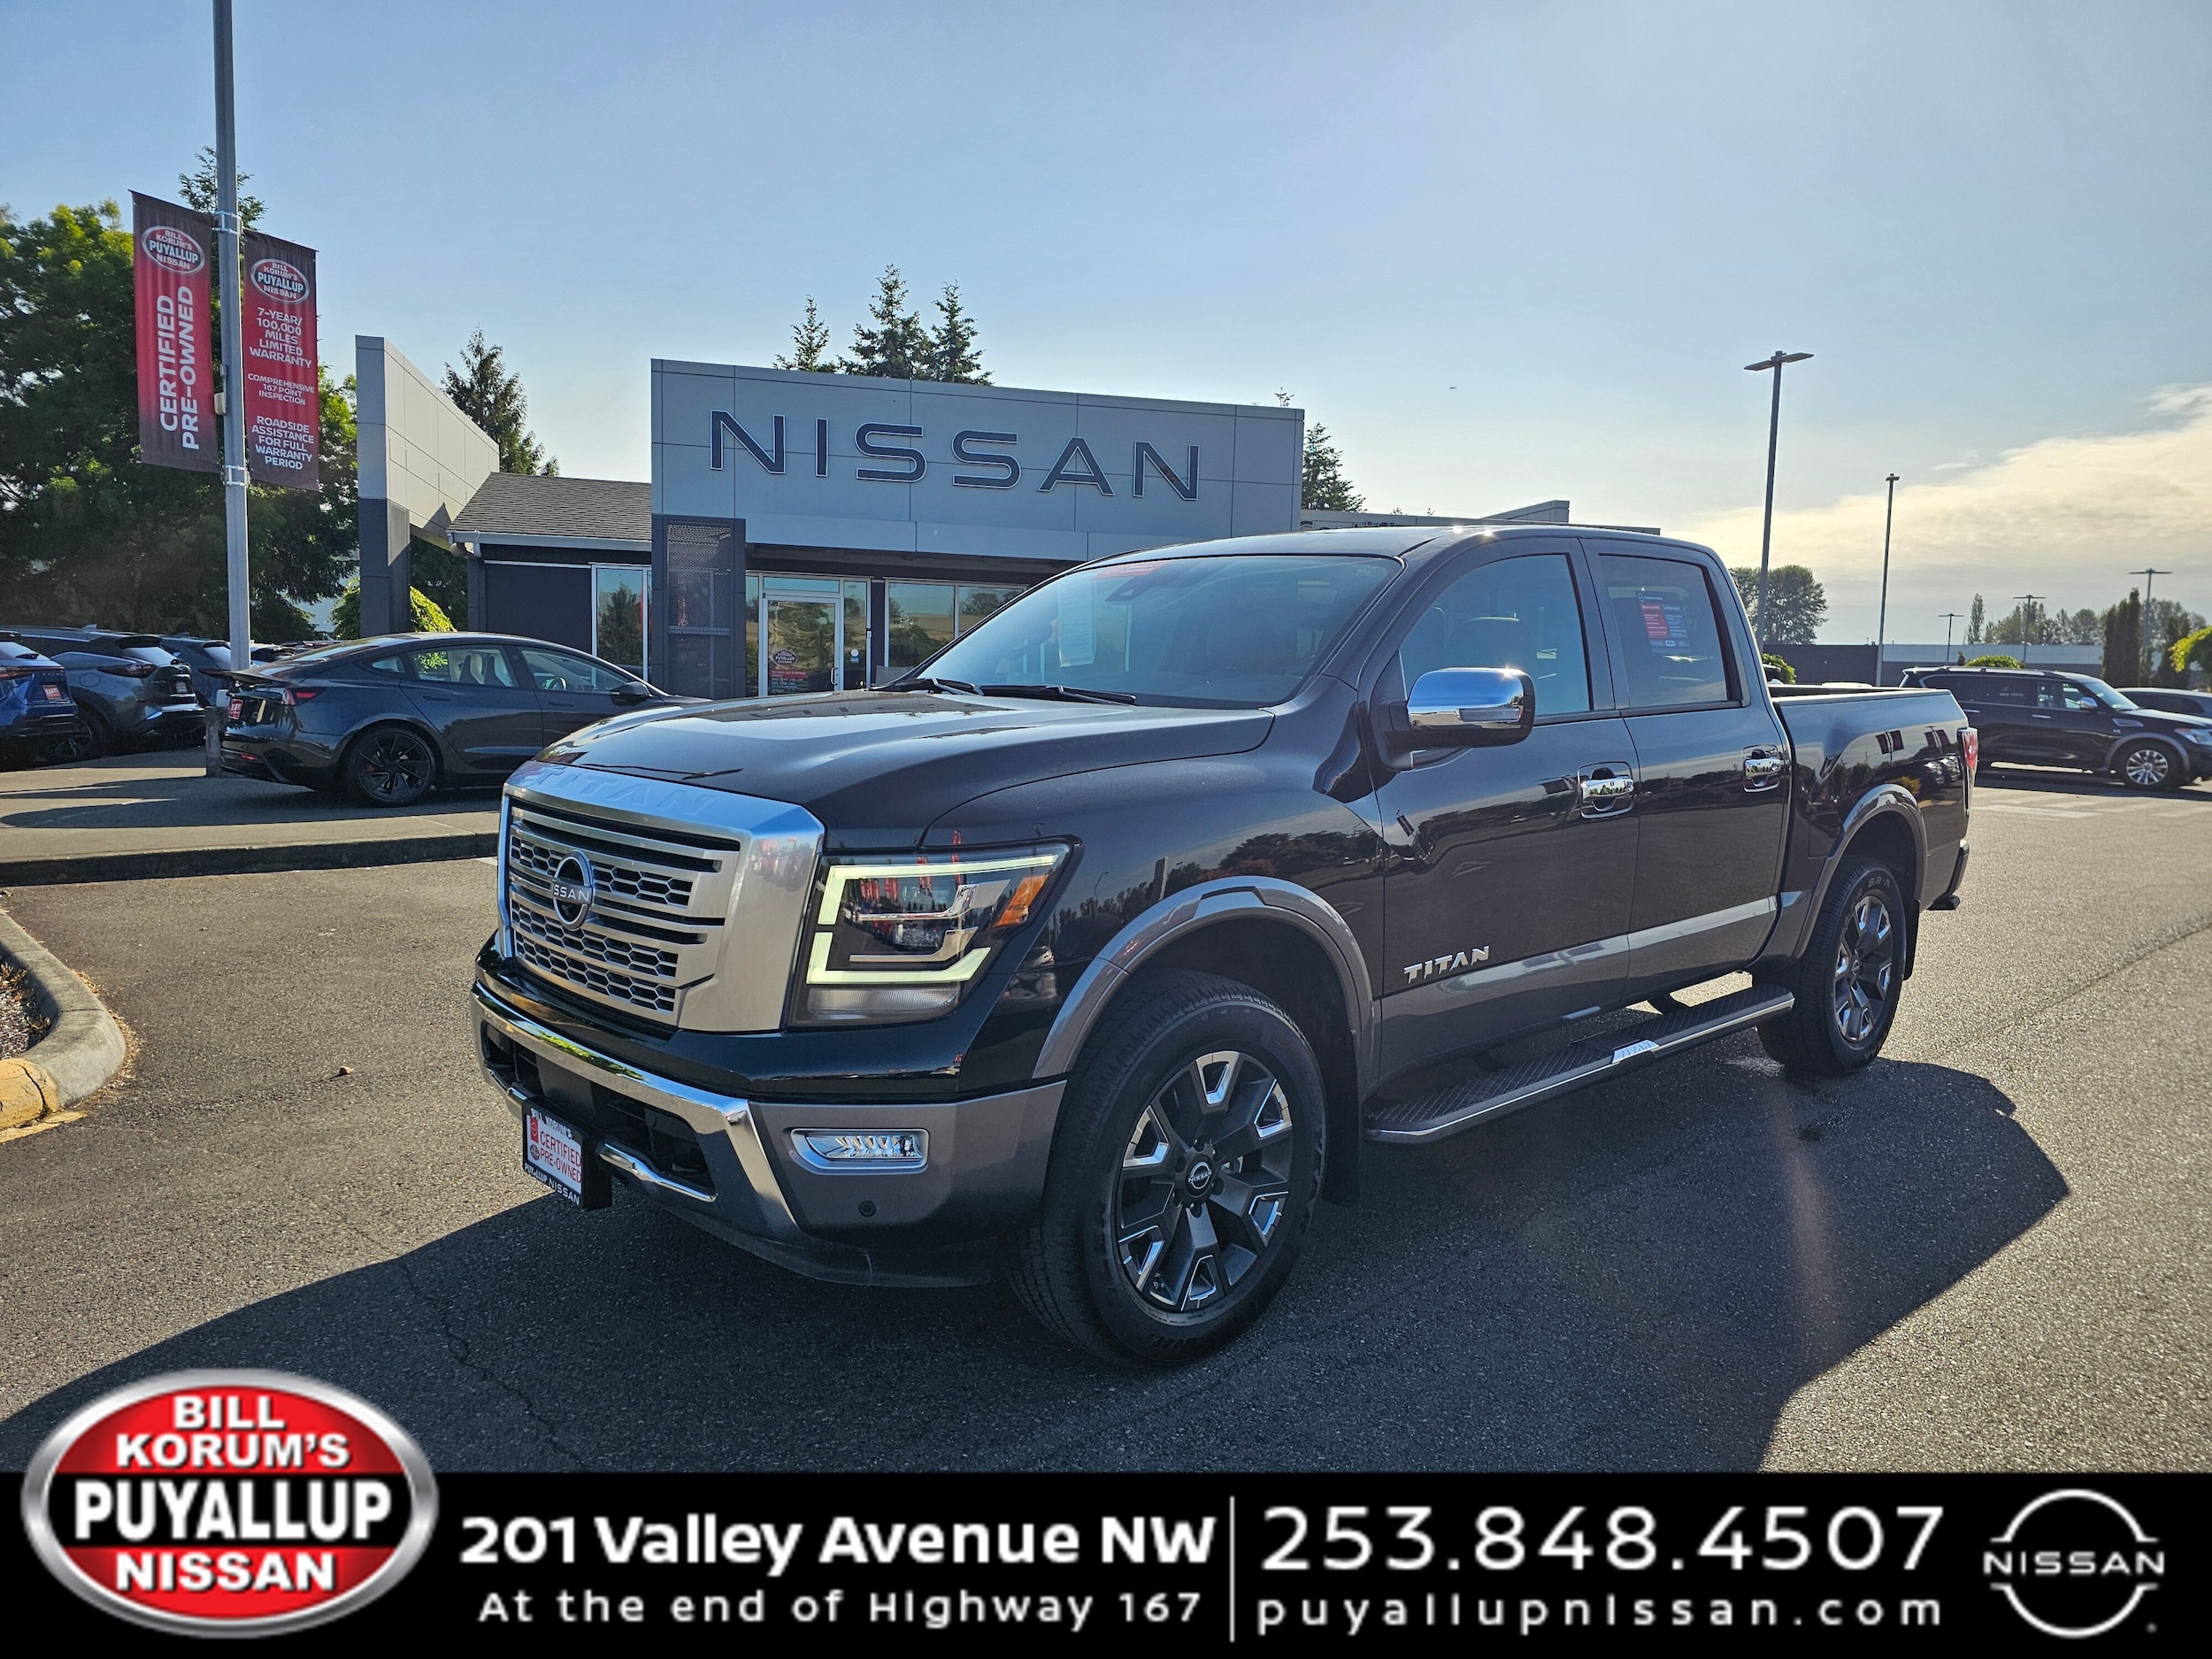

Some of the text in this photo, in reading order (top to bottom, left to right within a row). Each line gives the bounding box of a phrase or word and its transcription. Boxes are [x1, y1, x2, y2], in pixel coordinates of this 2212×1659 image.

[156, 234, 192, 250] KORUM'S
[165, 230, 182, 241] BILL
[149, 240, 199, 264] PUYALLUP
[157, 254, 190, 270] NISSAN
[272, 262, 288, 273] BILL
[264, 266, 298, 280] KORUM'S
[257, 272, 304, 293] PUYALLUP
[263, 284, 297, 299] NISSAN
[257, 307, 303, 326] 7-YEAR/
[257, 318, 302, 335] 100,000
[265, 329, 298, 344] MILES
[259, 338, 303, 356] LIMITED
[157, 295, 178, 432] CERTIFIED
[249, 346, 312, 368] WARRANTY
[178, 286, 200, 449] PRE-OWNED
[248, 373, 315, 393] COMPREHENSIVE
[263, 383, 302, 397] 167 POINT
[258, 390, 306, 405] INSPECTION
[251, 425, 315, 443] ASSISTANCE
[257, 416, 310, 434] ROADSIDE
[258, 435, 307, 452] FOR FULL
[255, 444, 313, 462] WARRANTY
[710, 410, 1200, 501] NISSAN
[265, 456, 303, 470] PERIOD
[536, 764, 718, 817] TITAN
[553, 884, 590, 902] SSAN
[1403, 945, 1490, 984] TITAN
[540, 1131, 582, 1167] CERTIFIED
[540, 1148, 582, 1183] PRE-OWNED
[549, 1178, 580, 1206] NISSAN
